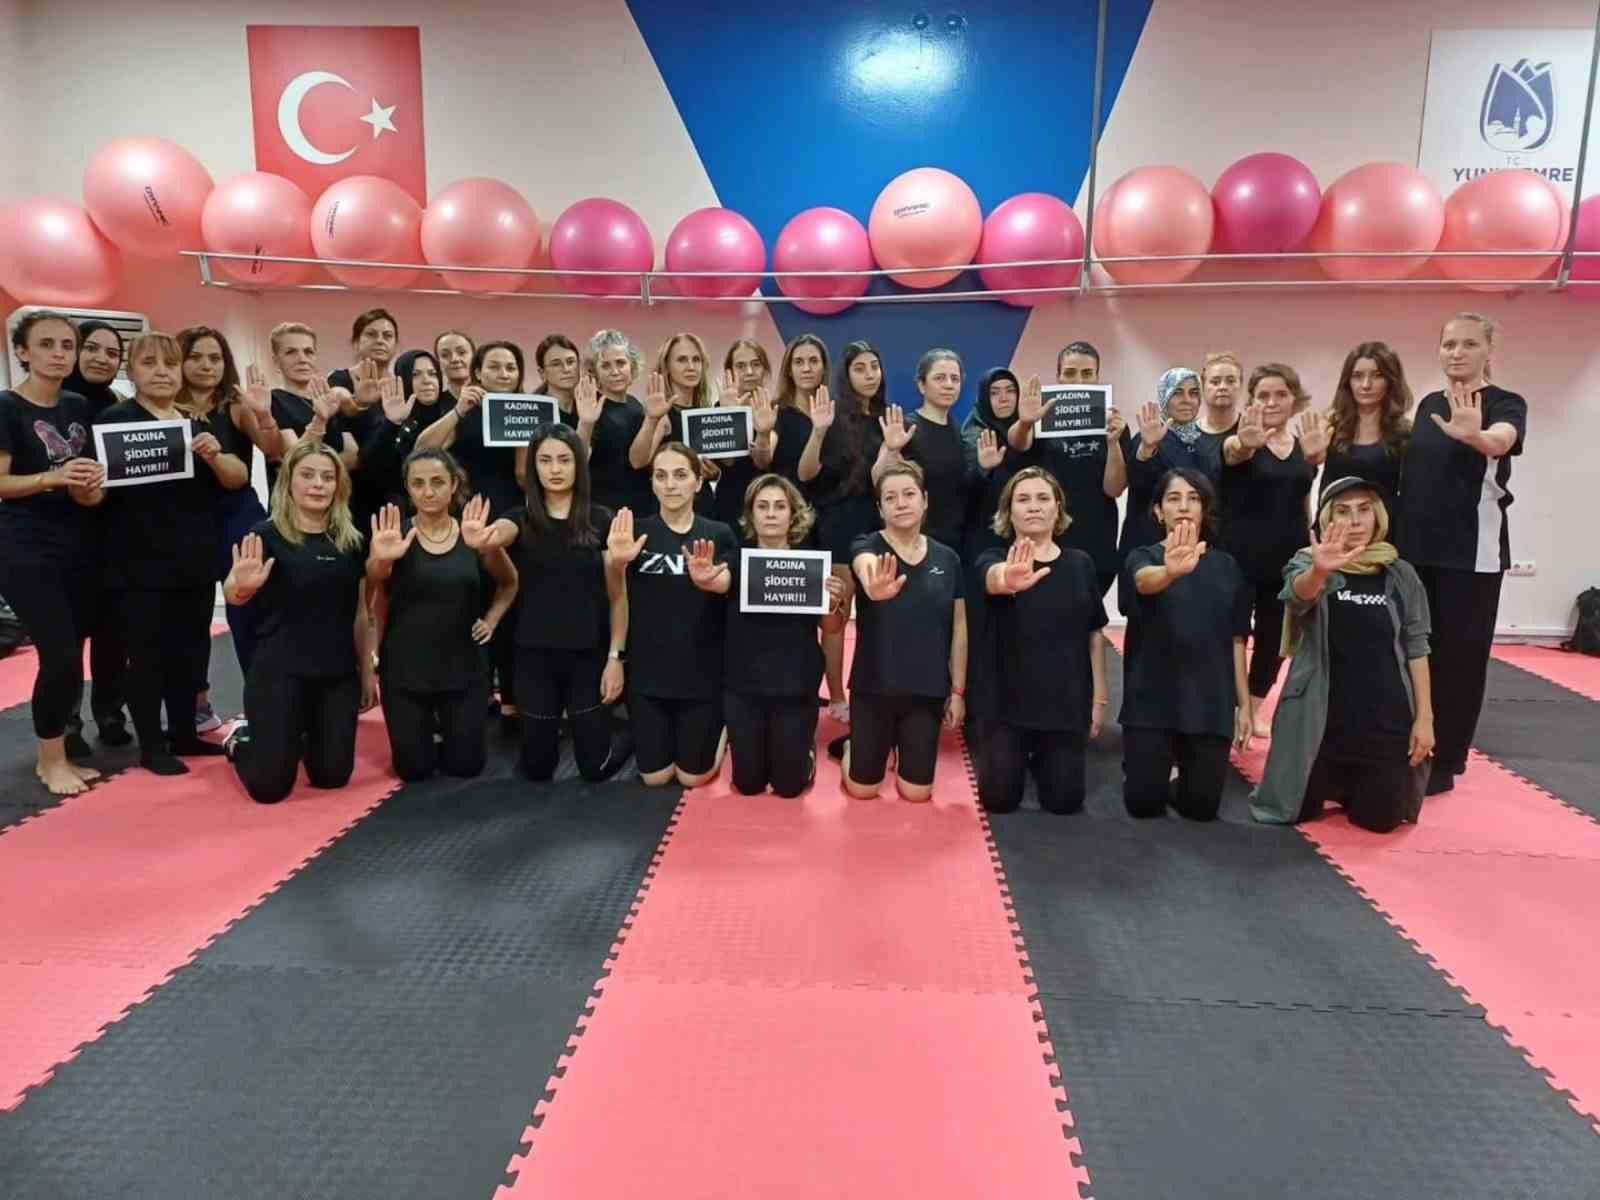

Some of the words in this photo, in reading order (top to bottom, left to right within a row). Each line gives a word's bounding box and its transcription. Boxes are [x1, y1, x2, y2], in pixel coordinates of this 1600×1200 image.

[1056, 392, 1090, 401] KADINA
[504, 402, 539, 411] KADINA
[701, 414, 733, 425] KADINA
[122, 431, 167, 443] KADINA
[124, 447, 169, 461] ŞİDDETE
[125, 462, 169, 475] HAYIR!!!
[766, 560, 806, 570] KADINA
[764, 575, 807, 587] ŞİDDETE
[764, 592, 807, 603] HAYIR!!!
